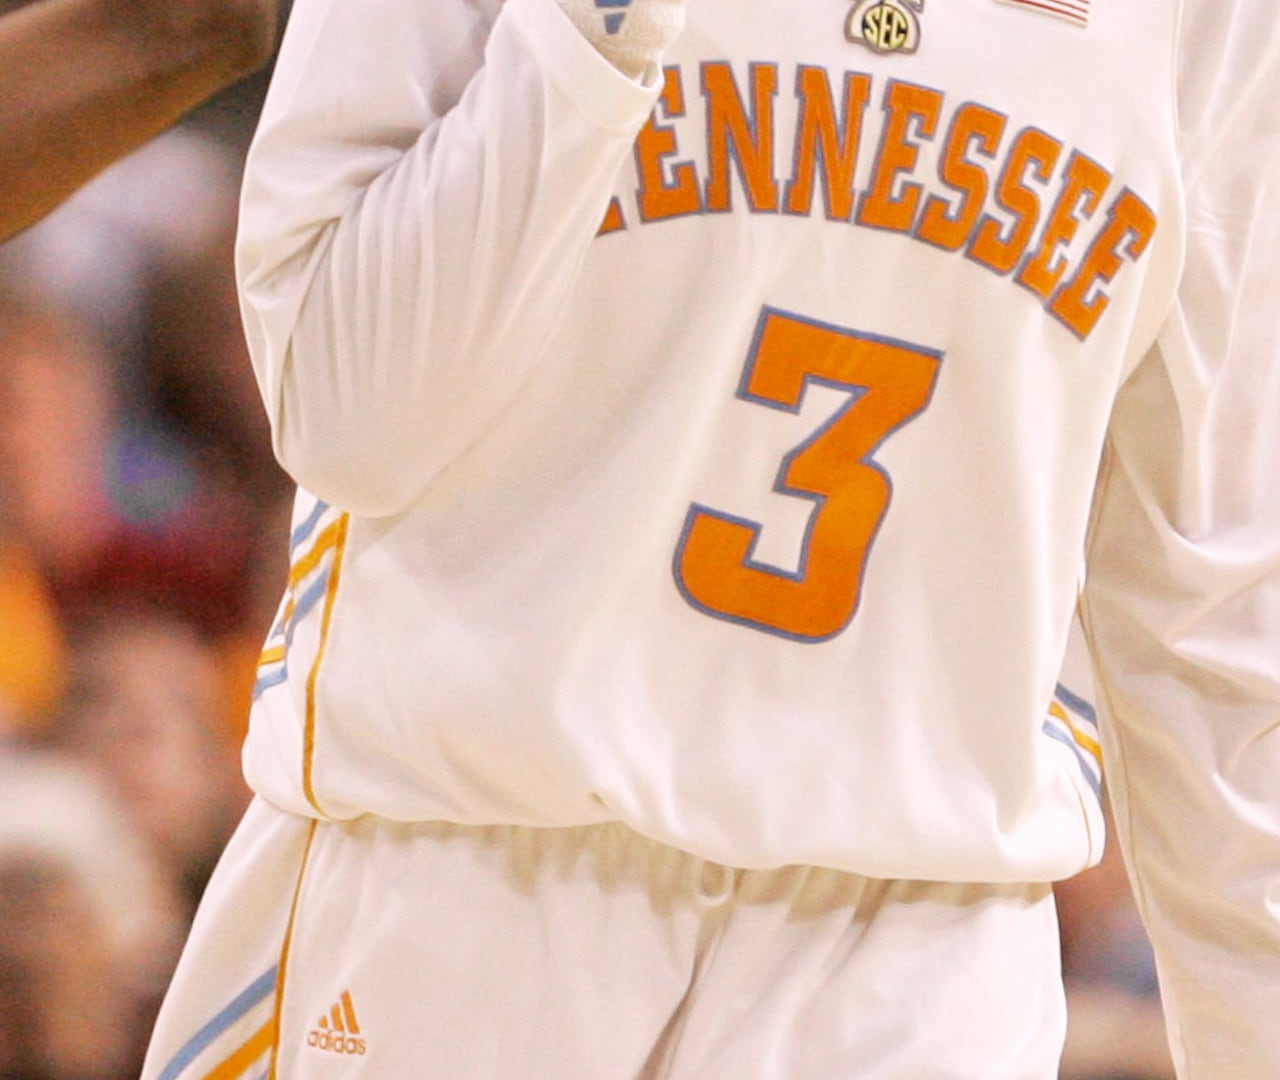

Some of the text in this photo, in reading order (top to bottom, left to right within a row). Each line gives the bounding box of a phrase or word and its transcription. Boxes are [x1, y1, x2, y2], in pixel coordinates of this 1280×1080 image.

[863, 6, 907, 50] SEC
[596, 61, 1157, 341] ENNESSEE
[672, 304, 946, 644] 3
[307, 1028, 366, 1055] adidas
